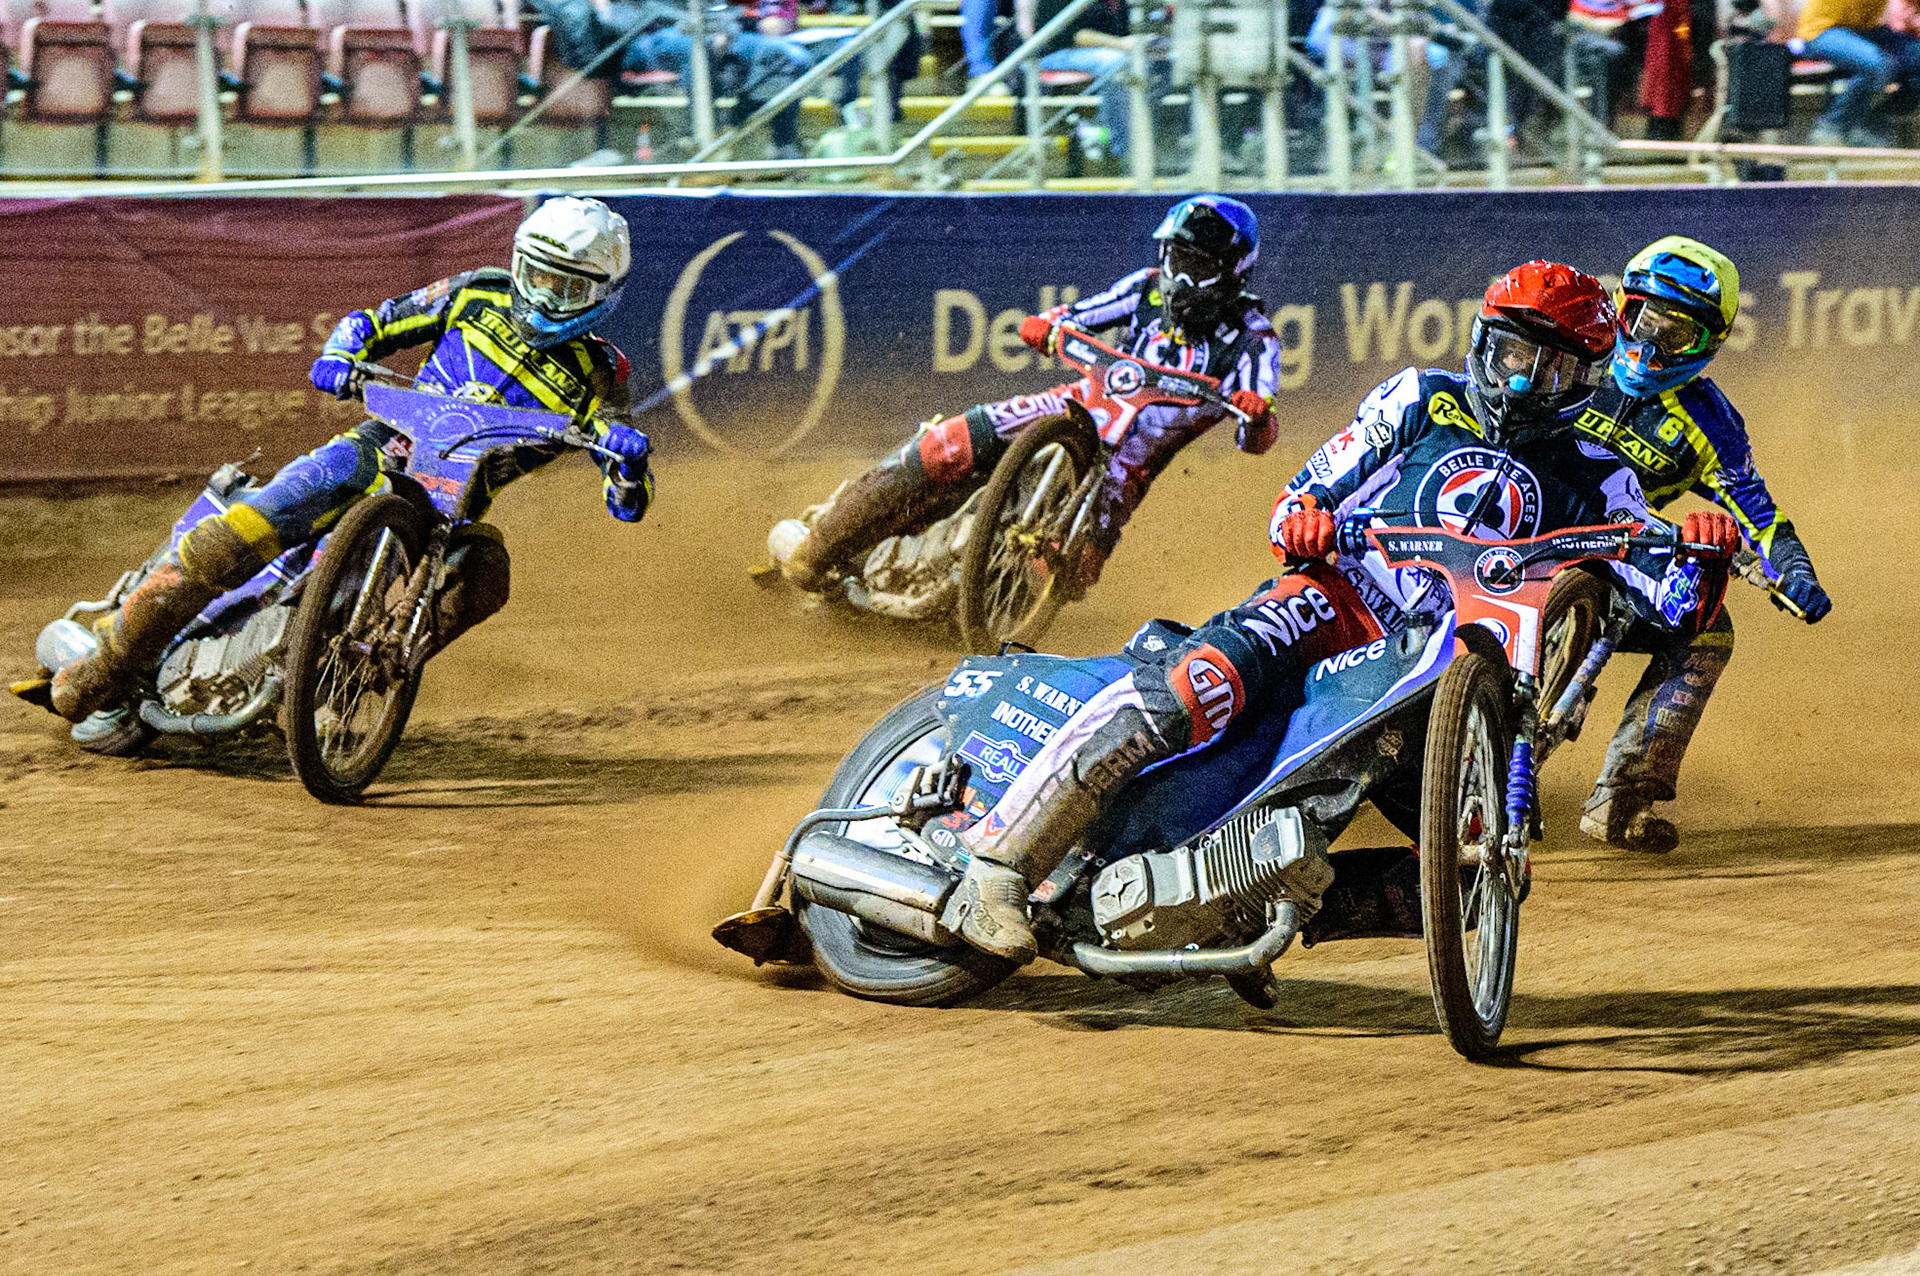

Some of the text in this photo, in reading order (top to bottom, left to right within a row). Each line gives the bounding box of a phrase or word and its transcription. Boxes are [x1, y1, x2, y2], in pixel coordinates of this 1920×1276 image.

[67, 312, 134, 355] the
[143, 313, 236, 355] Belle
[237, 315, 304, 354] Vue
[695, 310, 811, 373] ATPI
[1339, 279, 1484, 362] Wor
[64, 384, 174, 422] Junior
[180, 383, 306, 429] League
[1657, 417, 1684, 442] 6
[1438, 455, 1484, 478] BELLE
[1520, 482, 1536, 523] ACES
[1400, 541, 1443, 552] WARNER
[1242, 586, 1336, 656] Nice
[1315, 638, 1387, 681] Nice
[944, 670, 1004, 698] 55
[1032, 681, 1086, 717] WARN
[991, 700, 1060, 745] INOTHE
